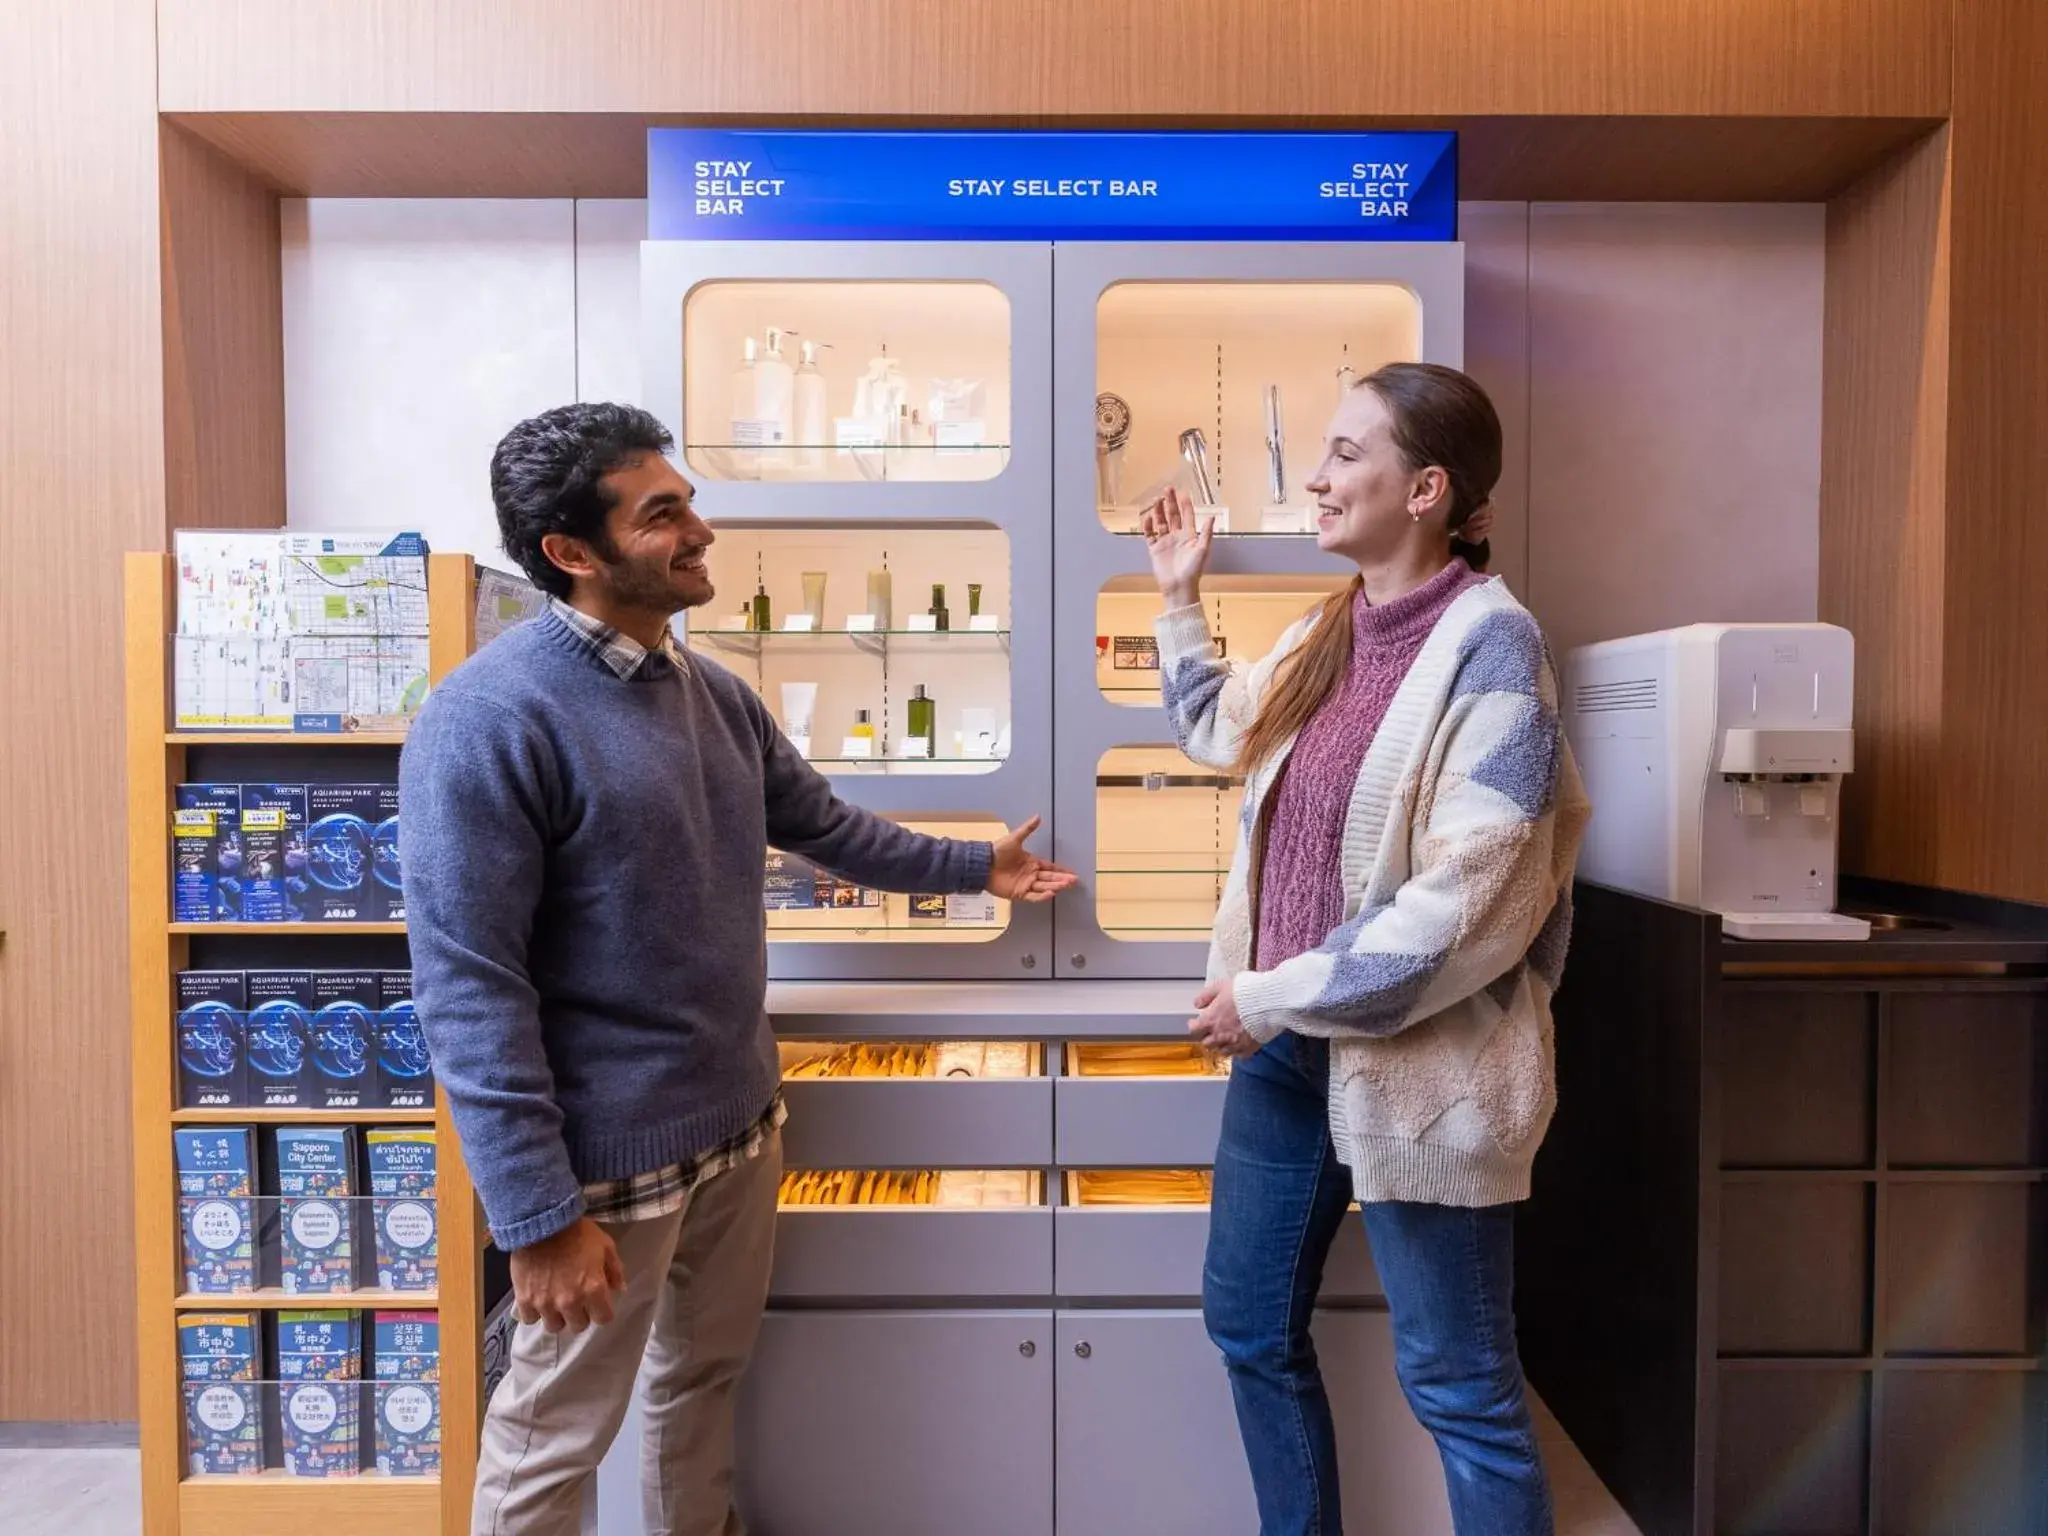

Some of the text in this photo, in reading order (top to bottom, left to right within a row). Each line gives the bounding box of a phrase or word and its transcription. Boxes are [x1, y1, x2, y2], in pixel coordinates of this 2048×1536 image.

[696, 162, 750, 177] STAY
[1353, 164, 1407, 178] STAY
[696, 181, 783, 195] SELECT
[950, 180, 1156, 195] STAY SELECT BAR
[1321, 183, 1408, 197] SELECT
[696, 199, 742, 214] BAR
[1362, 202, 1407, 215] BAR
[312, 789, 352, 797] AQUARIUM
[292, 1142, 330, 1152] Sapporo
[288, 1152, 336, 1164] City Center
[394, 1323, 423, 1335] 삿포로
[198, 1337, 234, 1348] 市中心
[295, 1335, 332, 1344] 市中心
[394, 1335, 424, 1345] 중심부
